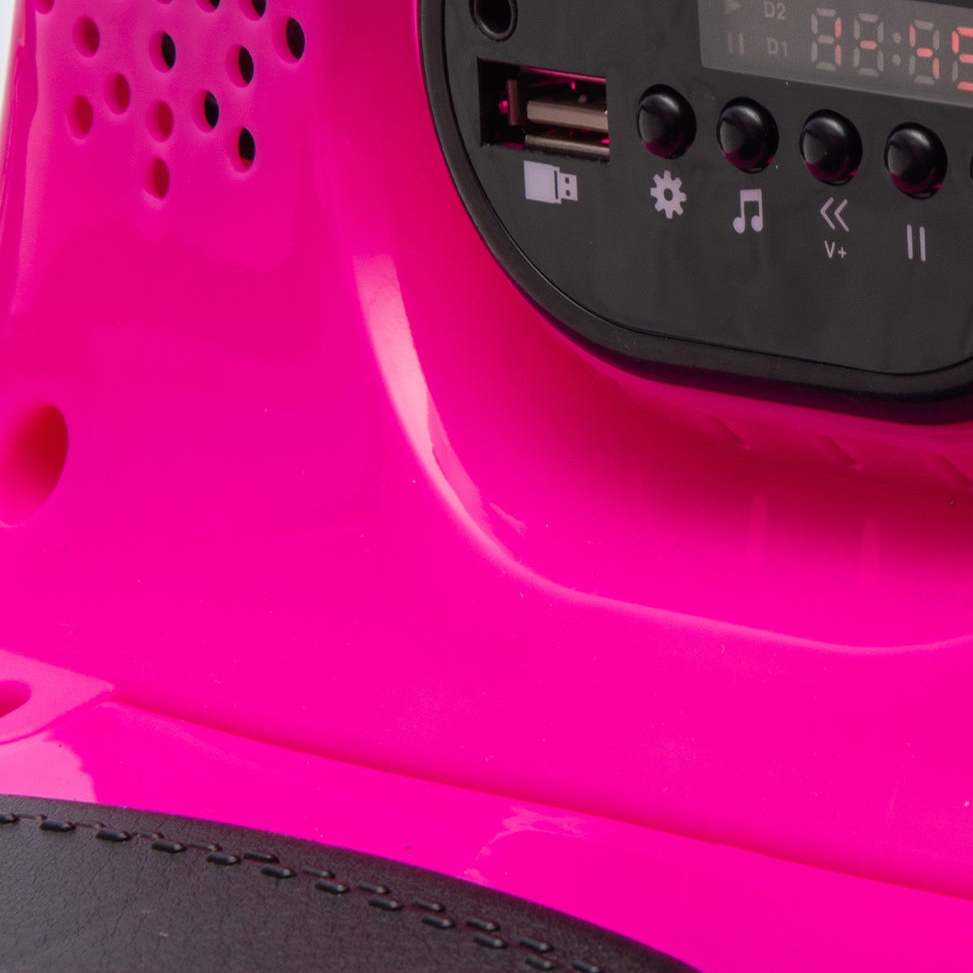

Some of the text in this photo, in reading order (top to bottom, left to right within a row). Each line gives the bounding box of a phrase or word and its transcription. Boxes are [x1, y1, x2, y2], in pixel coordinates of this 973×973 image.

[763, 1, 787, 19] D2
[767, 37, 788, 57] D1
[824, 240, 847, 258] V+
